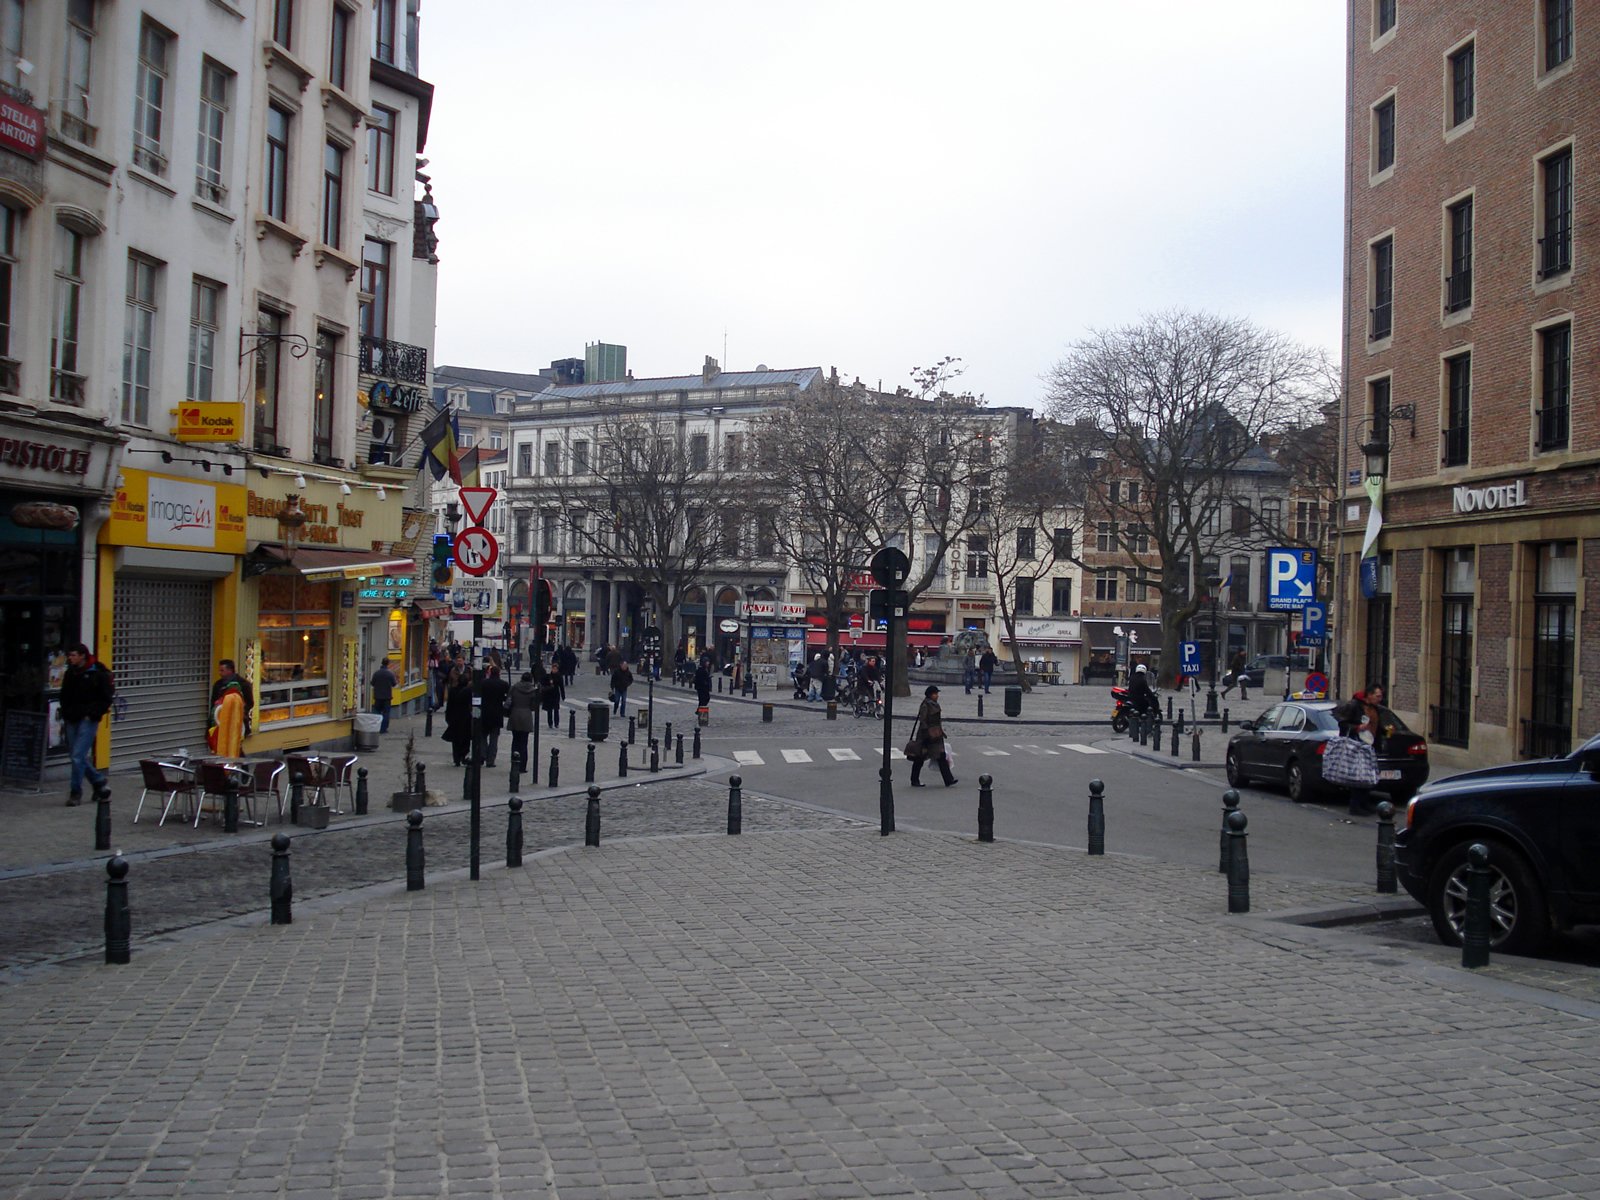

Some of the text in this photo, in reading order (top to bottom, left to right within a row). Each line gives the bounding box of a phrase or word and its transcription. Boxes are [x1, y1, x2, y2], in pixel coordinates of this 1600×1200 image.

[1, 104, 37, 132] STELLA
[0, 121, 37, 148] ARTOIS
[201, 416, 234, 426] Kodak
[212, 428, 234, 436] FILM
[1453, 480, 1527, 513] NOVOTEL
[126, 502, 145, 512] Kodak
[337, 502, 364, 528] TOAST
[132, 514, 145, 522] FILM
[233, 523, 244, 532] FILM
[1270, 553, 1298, 596] P
[1305, 607, 1323, 630] P
[1184, 644, 1196, 662] P
[1182, 664, 1200, 673] TAXI
